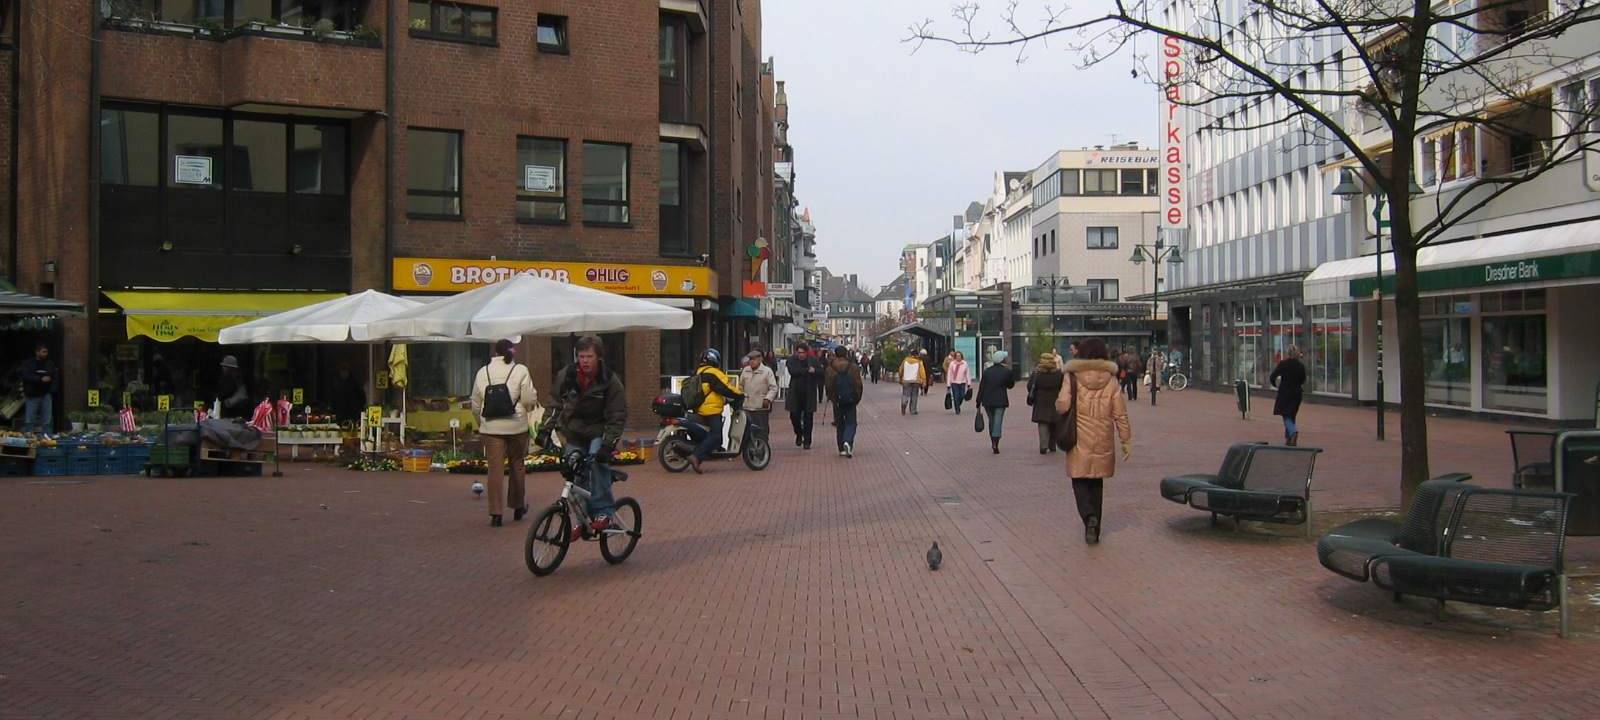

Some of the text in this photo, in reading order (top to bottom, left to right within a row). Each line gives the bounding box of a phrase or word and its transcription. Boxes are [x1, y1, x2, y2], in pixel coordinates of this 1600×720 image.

[1164, 36, 1181, 224] Sparkasse
[586, 267, 630, 282] OHLIG
[1486, 259, 1539, 281] Dresdner Bank
